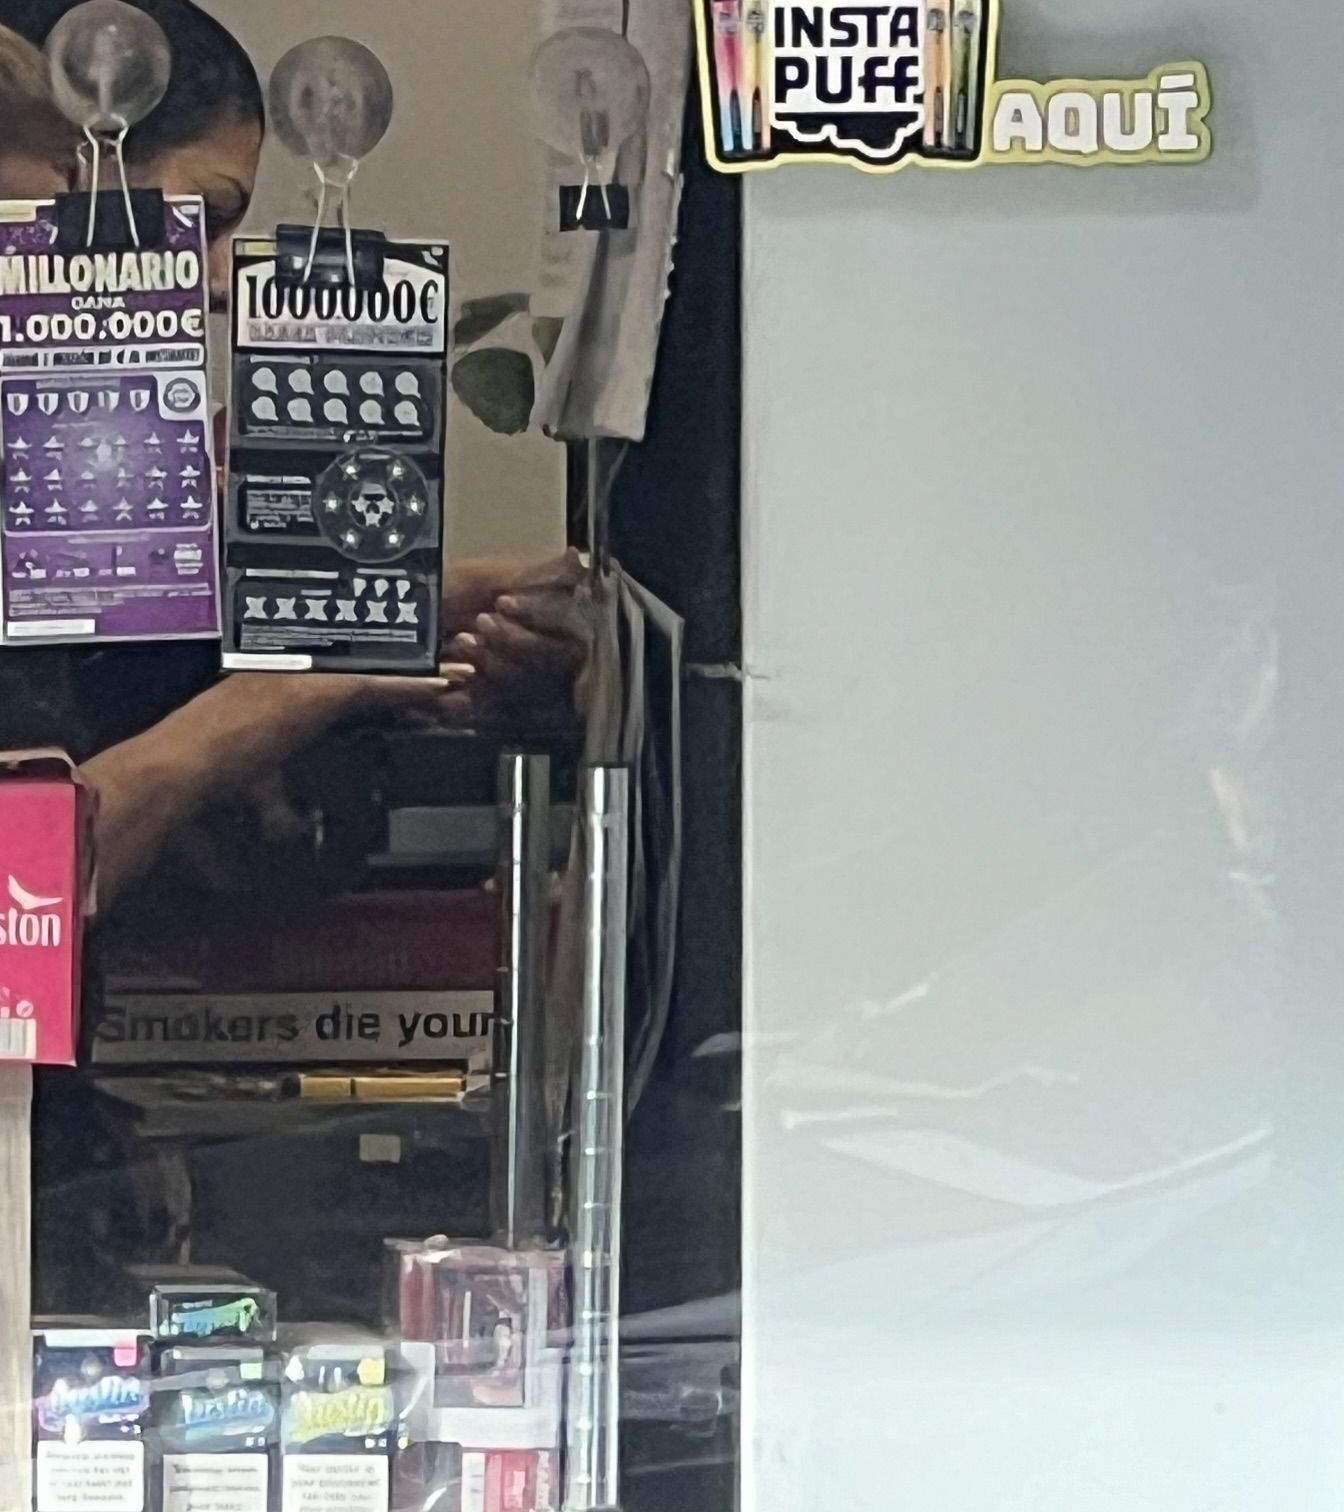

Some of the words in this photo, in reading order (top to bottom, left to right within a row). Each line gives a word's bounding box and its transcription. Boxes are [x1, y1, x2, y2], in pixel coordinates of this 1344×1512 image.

[774, 6, 920, 49] INSTA
[992, 74, 1201, 155] AQUÍ
[315, 1001, 381, 1042] die
